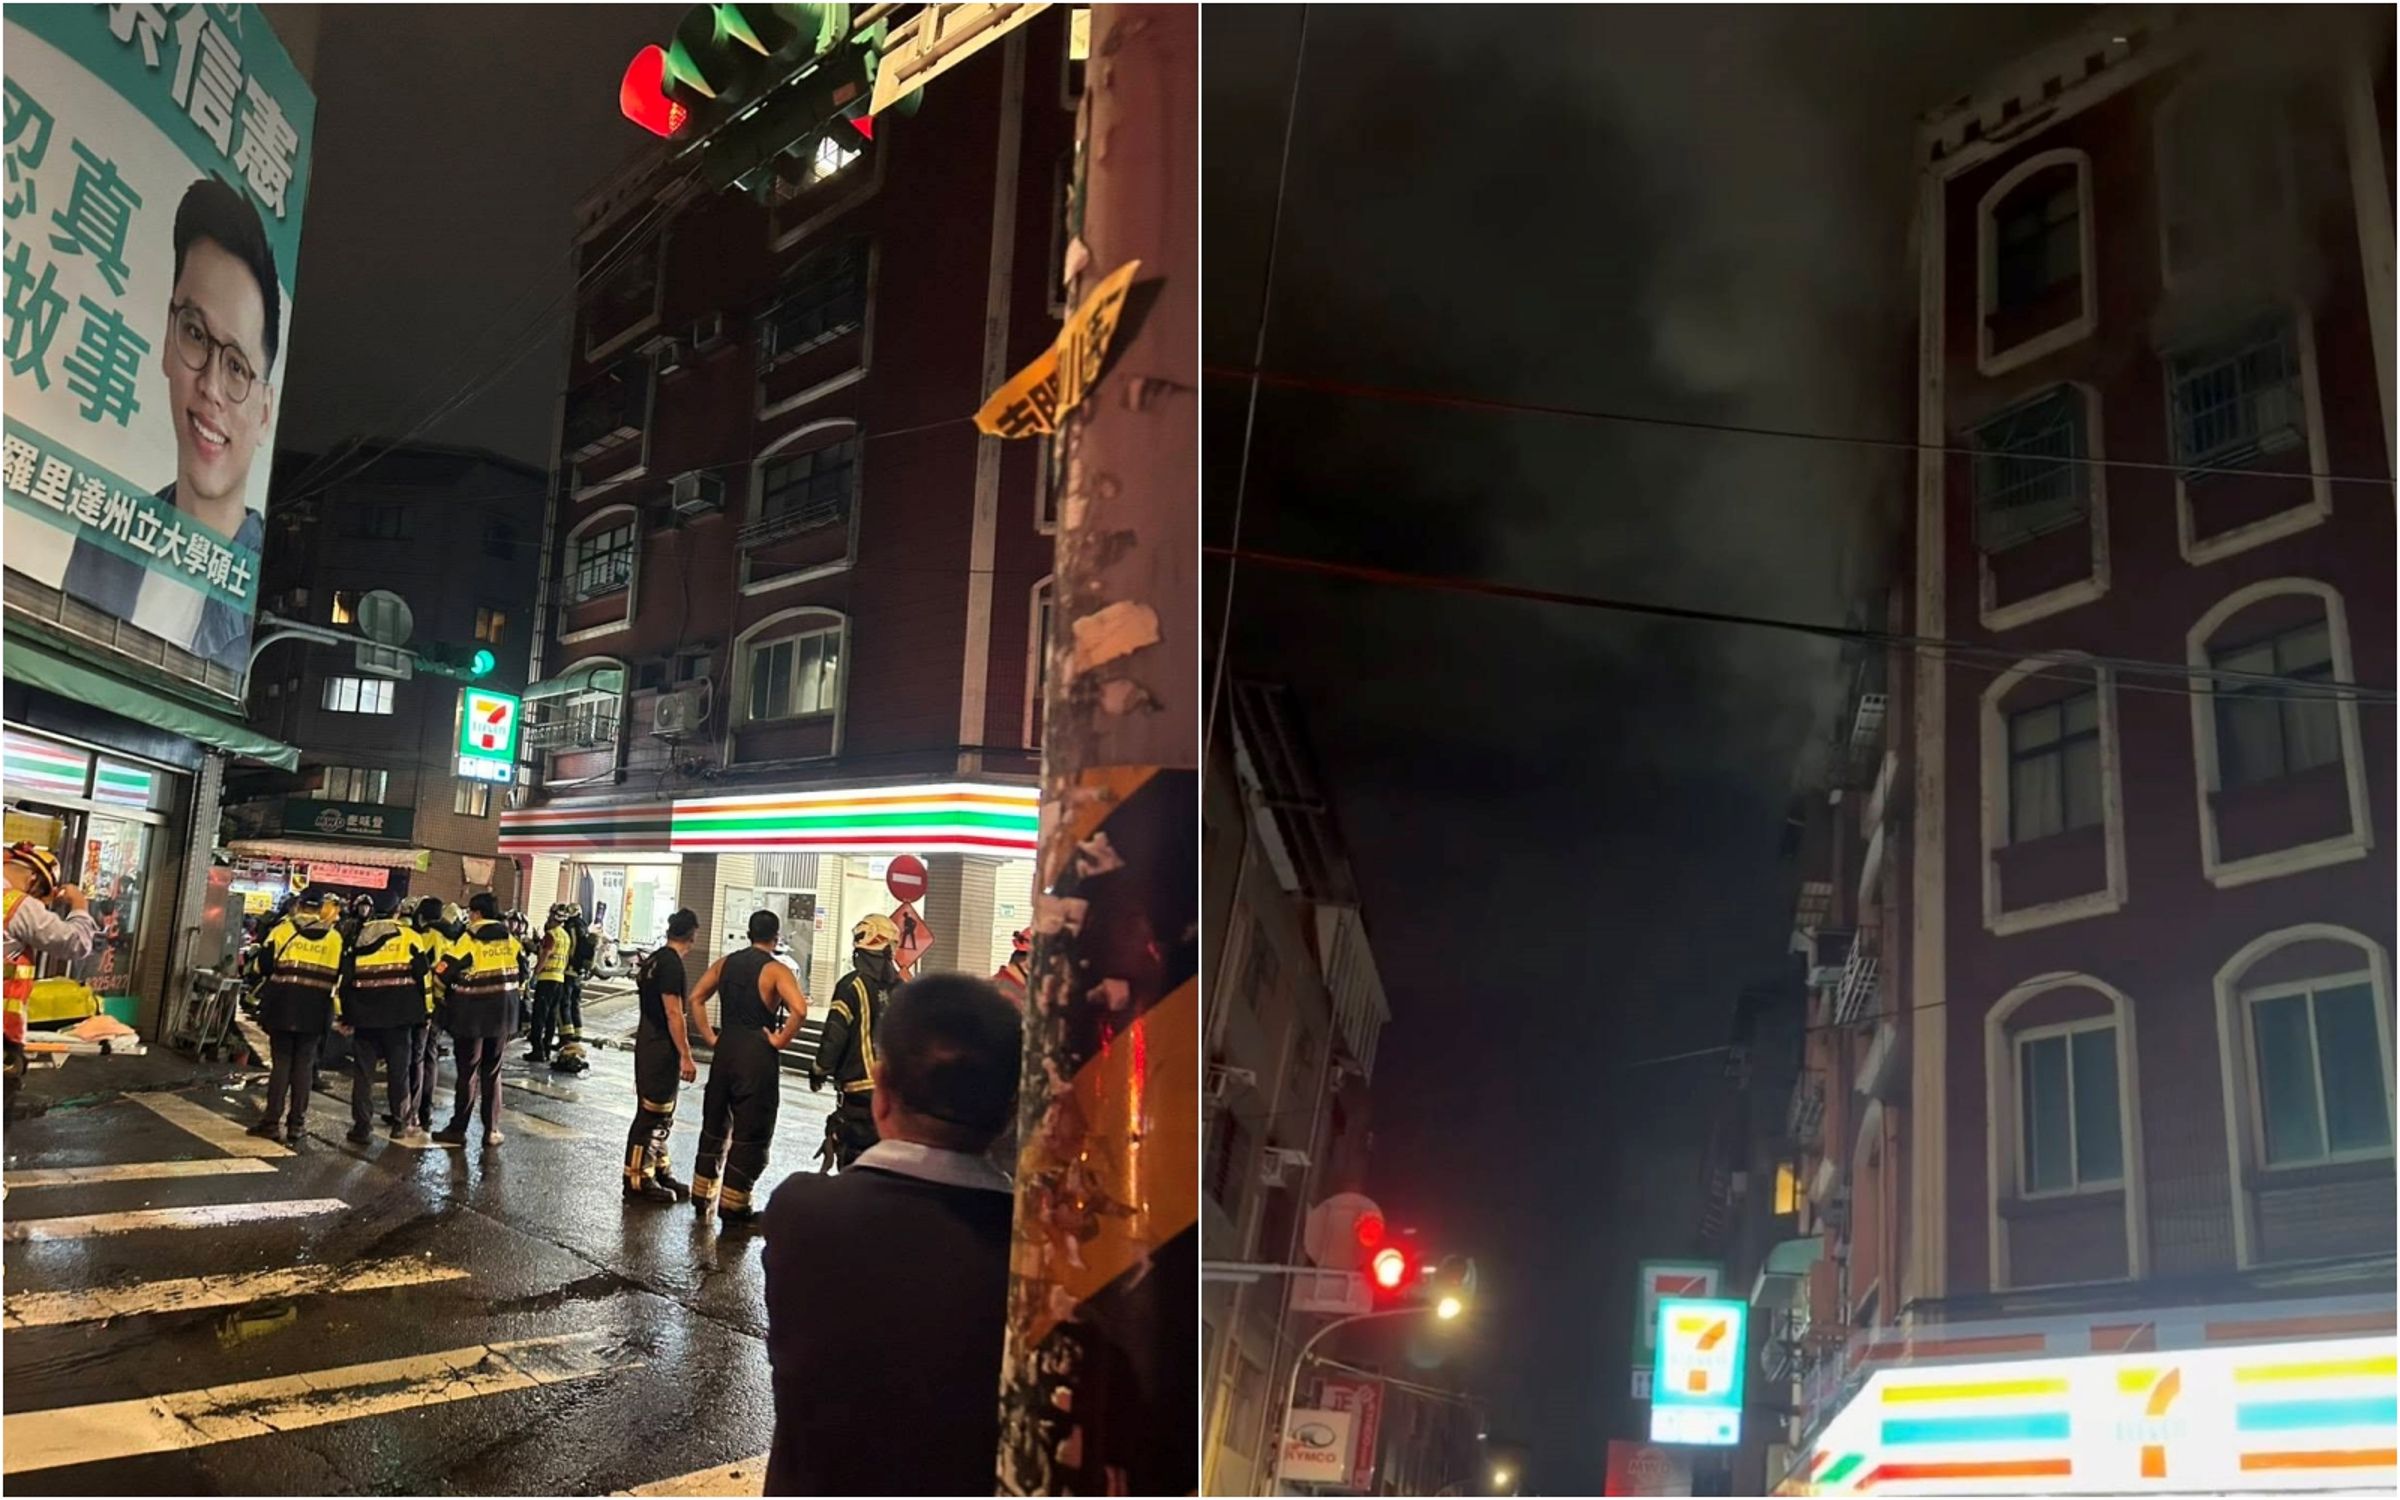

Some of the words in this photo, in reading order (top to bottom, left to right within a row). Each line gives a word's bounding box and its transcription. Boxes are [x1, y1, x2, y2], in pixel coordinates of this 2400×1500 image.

[3, 433, 252, 598] 羅里達州立大學碩士
[476, 699, 506, 748] 7
[290, 941, 329, 954] POLICE
[482, 946, 514, 958] POLICE
[1676, 1317, 1727, 1392] 7
[2116, 1366, 2181, 1478] 7
[1284, 1449, 1336, 1464] KYMCO
